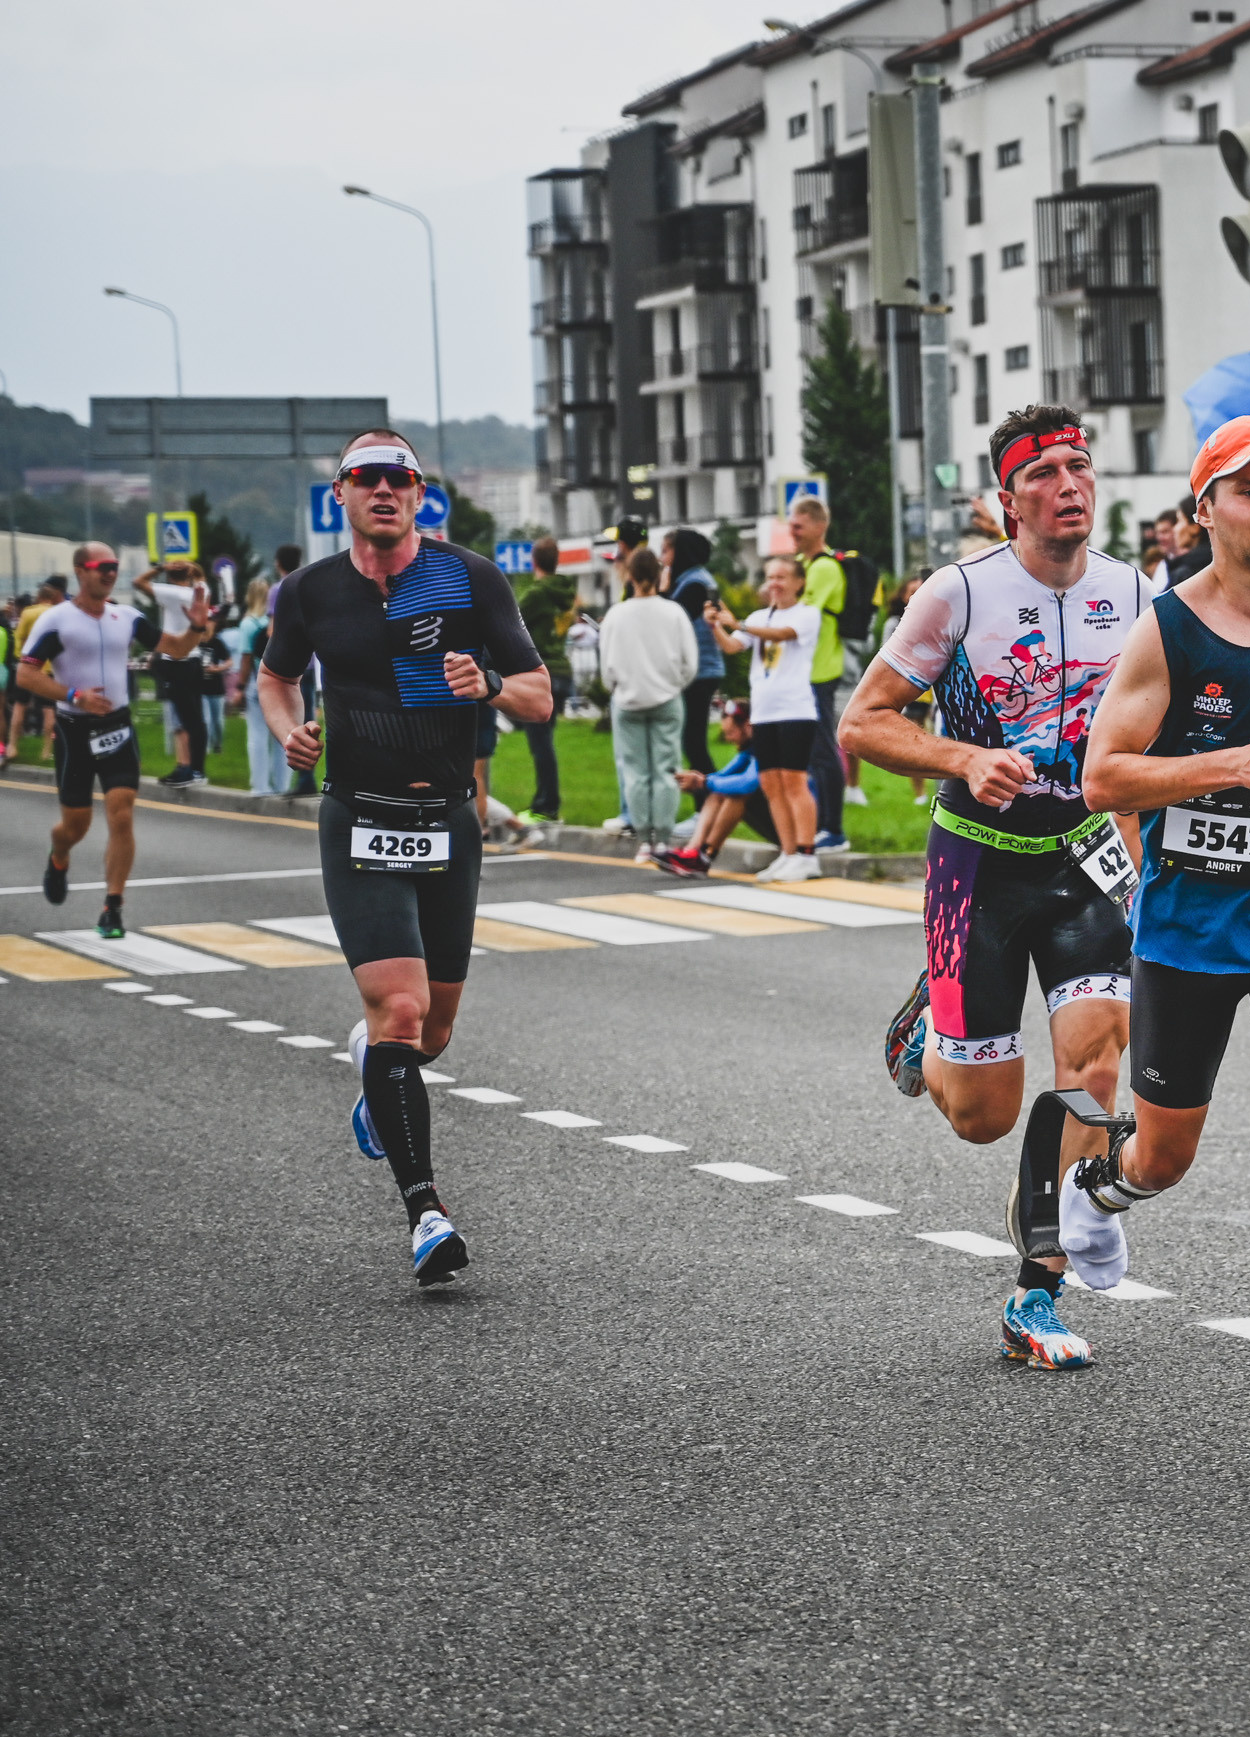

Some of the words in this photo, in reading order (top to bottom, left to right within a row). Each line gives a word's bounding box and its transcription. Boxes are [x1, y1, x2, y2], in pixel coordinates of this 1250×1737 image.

[1055, 432, 1075, 441] 2XU
[1195, 695, 1231, 706] ИНТЕР
[368, 835, 432, 857] 4269
[387, 861, 412, 869] SERGEY
[1206, 860, 1242, 873] ANDREY
